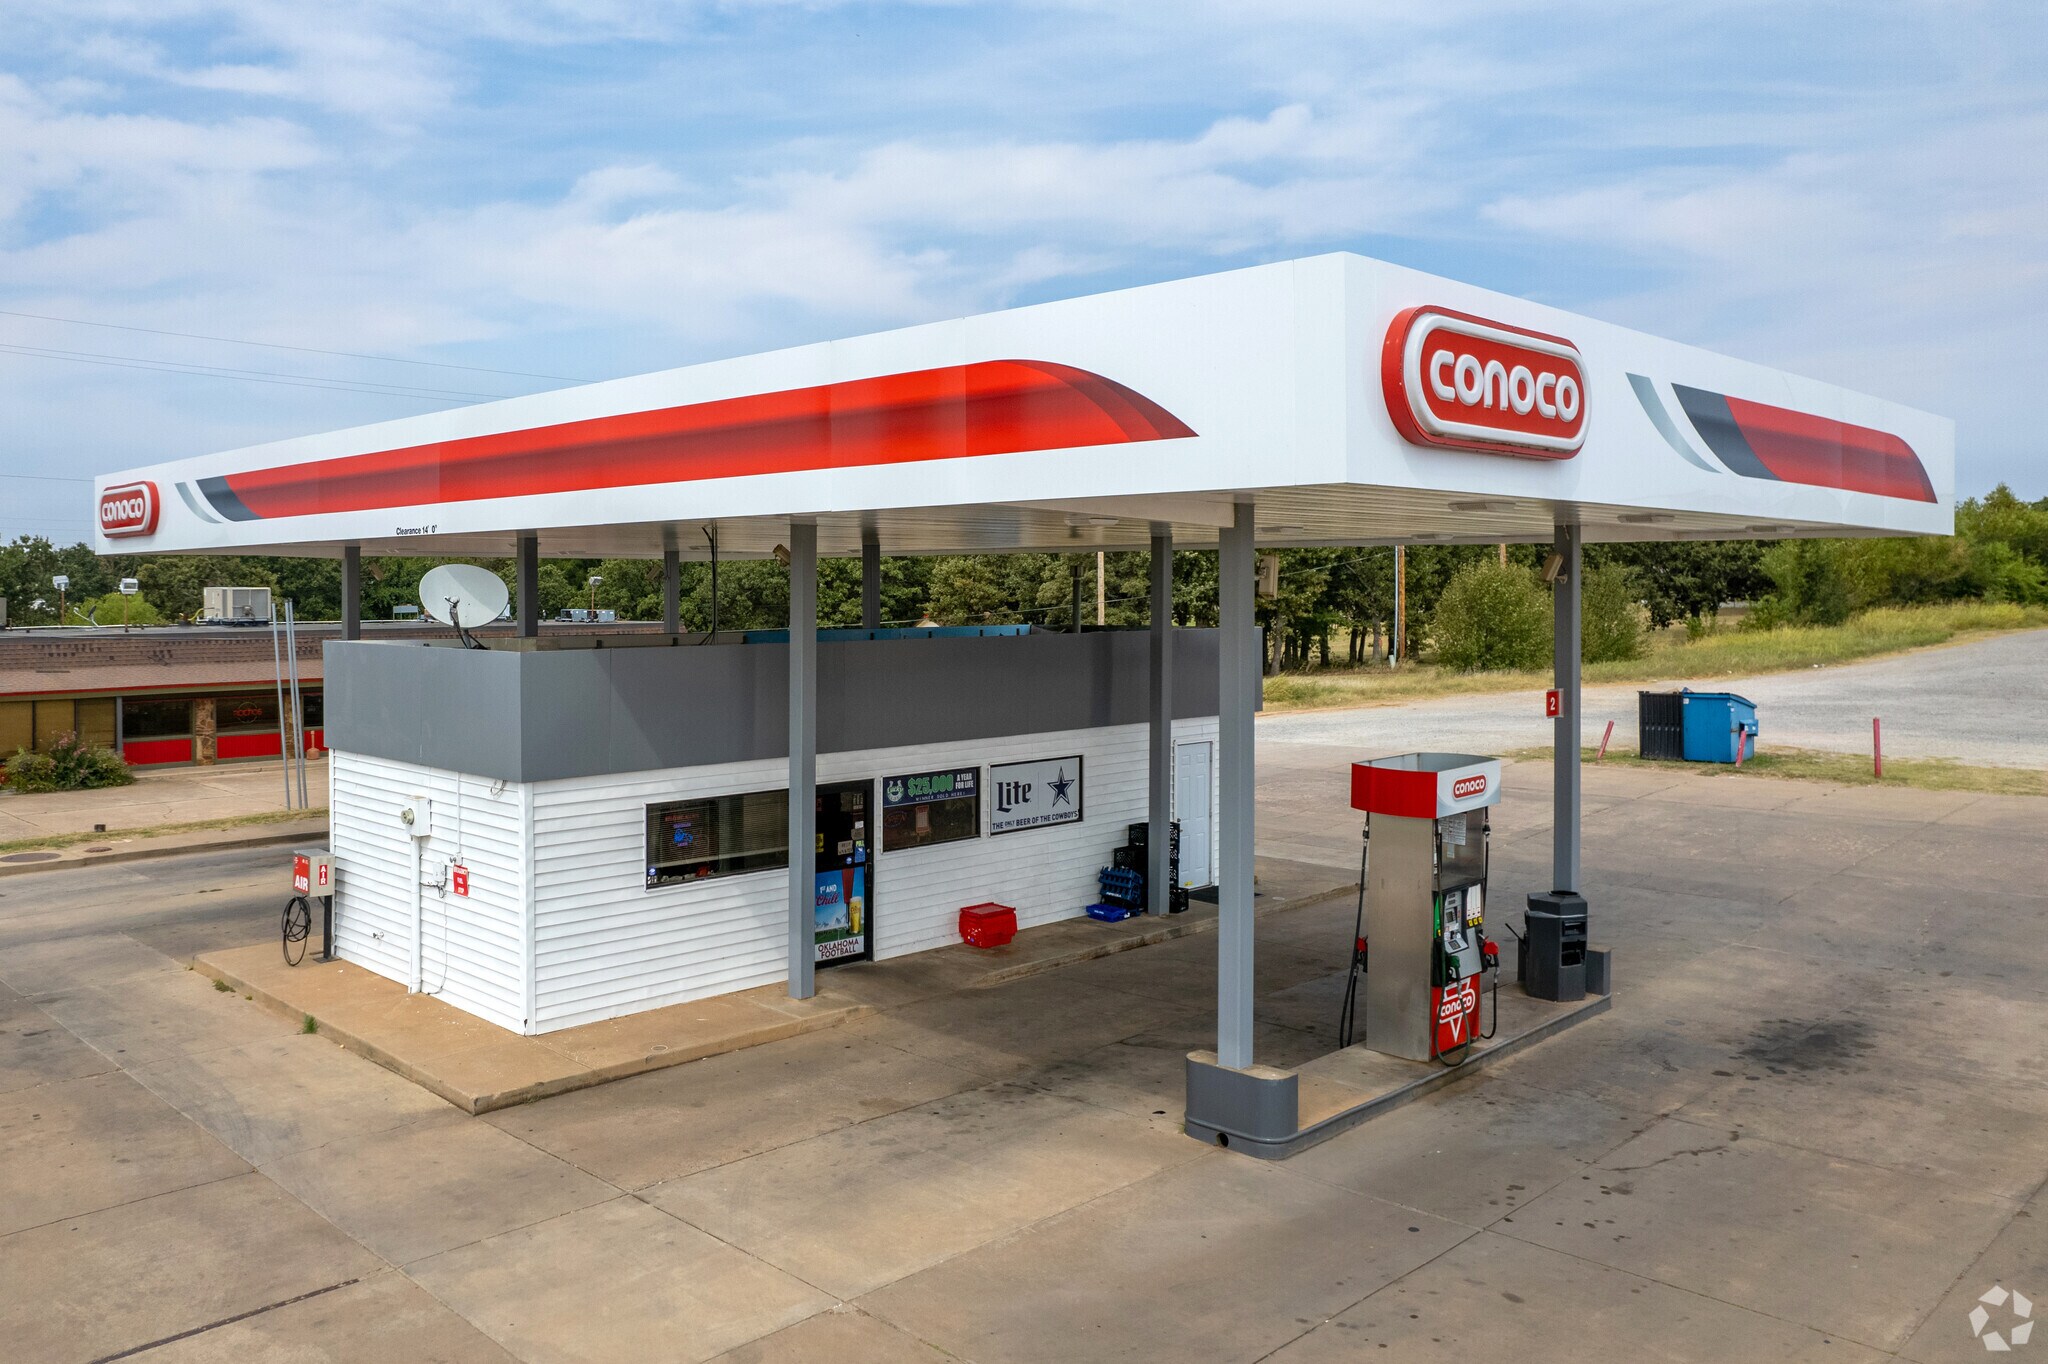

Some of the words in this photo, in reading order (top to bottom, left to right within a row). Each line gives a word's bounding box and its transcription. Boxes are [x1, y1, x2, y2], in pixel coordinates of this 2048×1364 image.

[395, 527, 421, 535] Clearance
[1550, 696, 1555, 711] 2
[956, 774, 961, 782] A
[961, 772, 972, 781] YEAR
[908, 773, 954, 797] $25,000
[955, 781, 964, 790] FOR
[964, 780, 974, 788] LIFE
[996, 780, 1032, 813] Lite
[992, 822, 1004, 830] THE
[1016, 817, 1031, 827] BEER
[1032, 816, 1040, 824] OF
[1040, 814, 1051, 823] THE
[1051, 810, 1079, 821] COWBOYS
[294, 874, 309, 891] AIR
[826, 884, 837, 893] AND
[816, 892, 840, 906] Chill
[818, 938, 859, 952] OKLAHOMA
[820, 946, 856, 959] FOOTBALL
